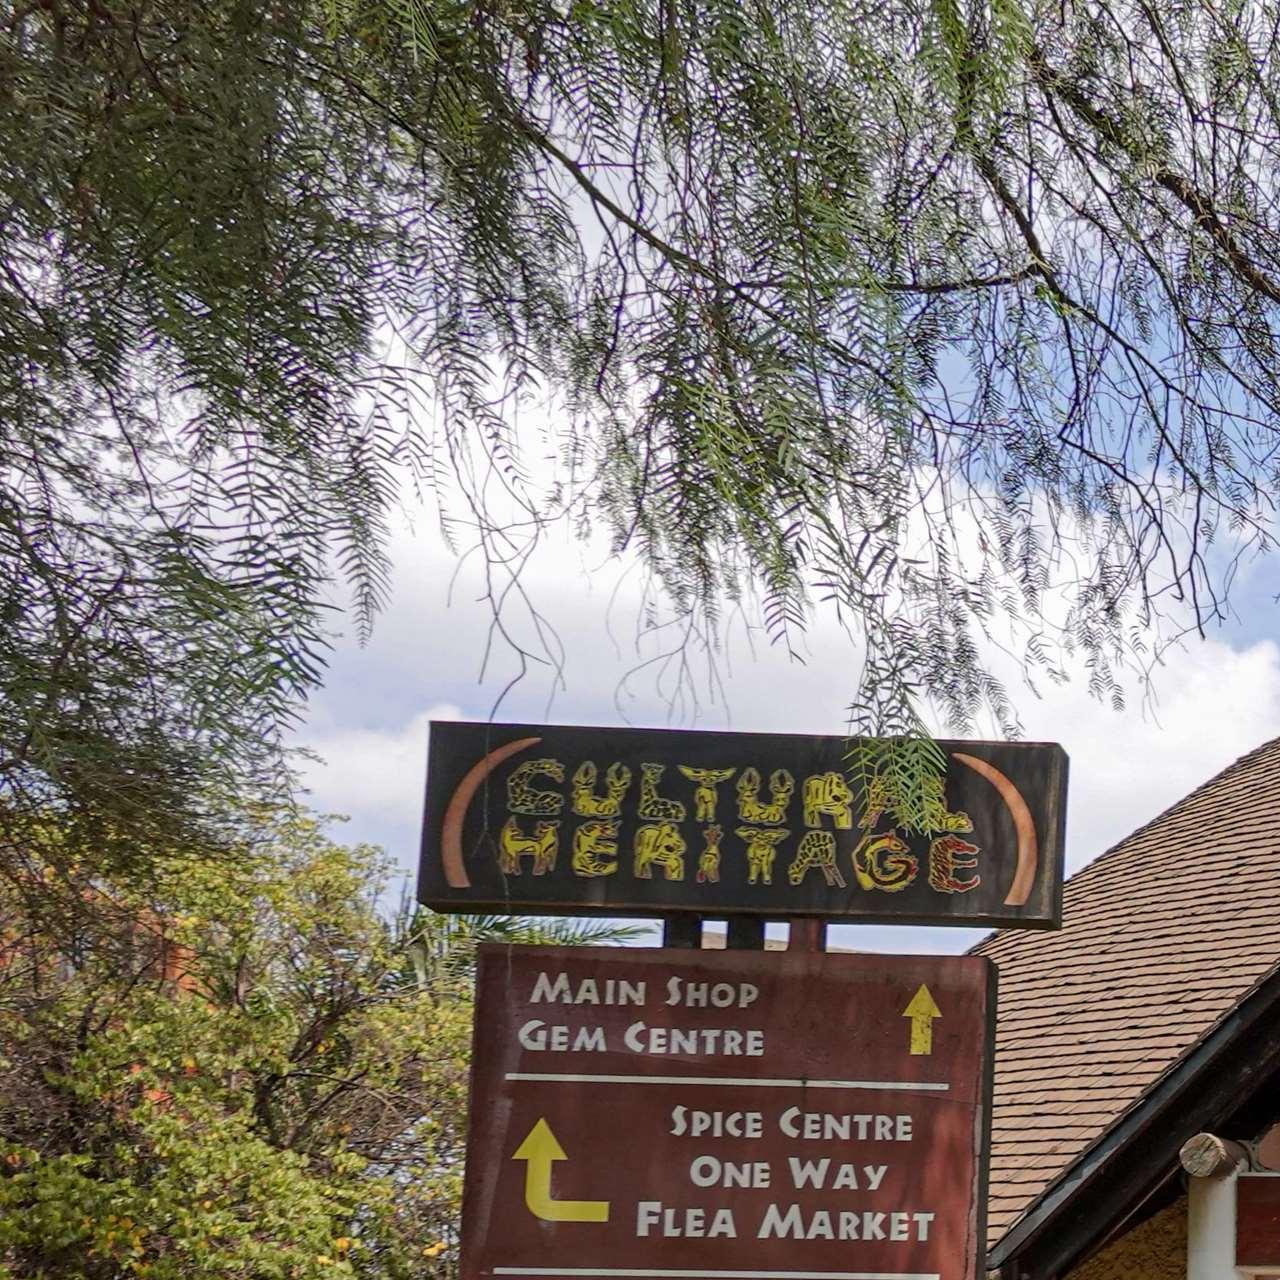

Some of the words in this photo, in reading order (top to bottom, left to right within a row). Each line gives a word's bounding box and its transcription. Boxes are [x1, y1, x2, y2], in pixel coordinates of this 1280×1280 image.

[500, 815, 981, 894] HERITAGE
[529, 972, 646, 1006] MAIN
[665, 976, 758, 1008] SHOP
[518, 1019, 607, 1052] GEM
[624, 1021, 764, 1056] CENTRE
[670, 1105, 763, 1138] SPICE
[779, 1106, 913, 1141] CENTRE
[689, 1155, 771, 1189] ONE
[788, 1157, 888, 1191] WAY
[636, 1201, 737, 1238] FLEA
[757, 1203, 936, 1242] MARKET
